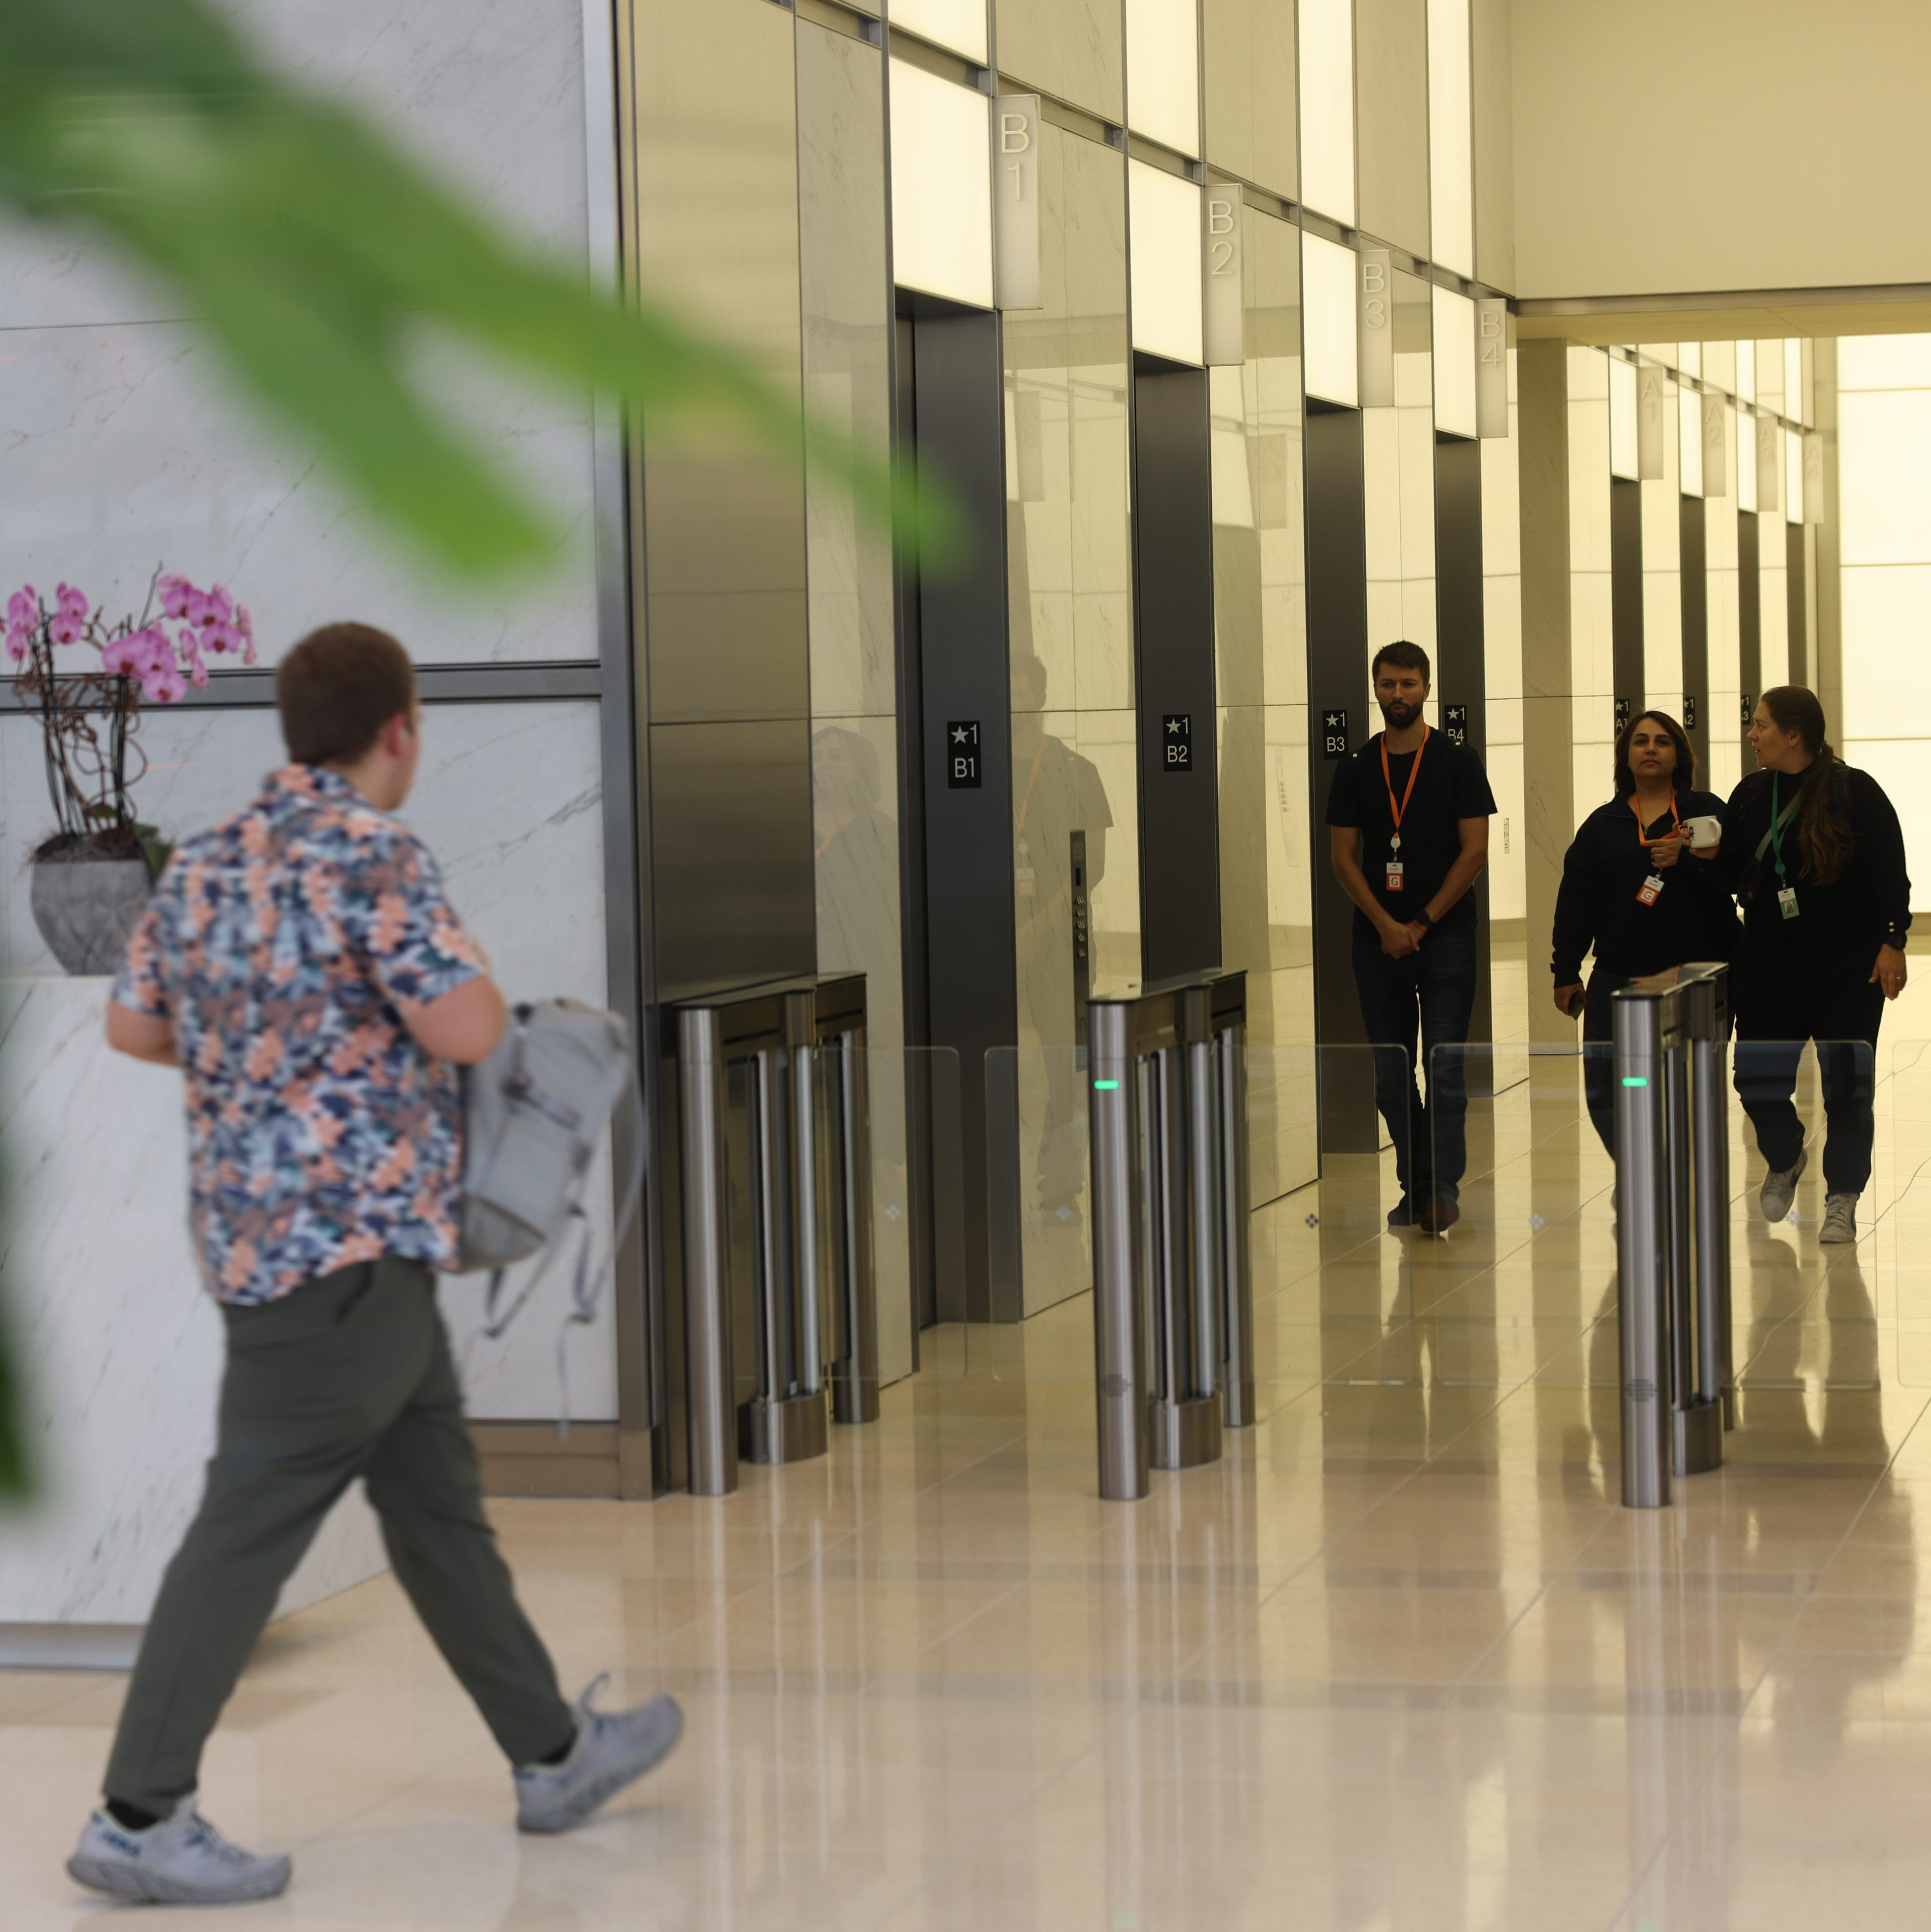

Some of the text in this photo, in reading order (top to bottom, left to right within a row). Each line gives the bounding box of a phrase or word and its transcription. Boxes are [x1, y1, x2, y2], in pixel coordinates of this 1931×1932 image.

[1624, 700, 1629, 712] 1
[1689, 699, 1694, 709] 1
[1339, 712, 1345, 727] 1
[1459, 707, 1465, 720] 1
[1182, 717, 1188, 734] 1
[970, 724, 977, 744] 1
[1327, 736, 1345, 752] B3
[1167, 745, 1188, 763] B2
[954, 757, 975, 778] B1
[1391, 877, 1398, 886] G
[1643, 891, 1652, 900] G
